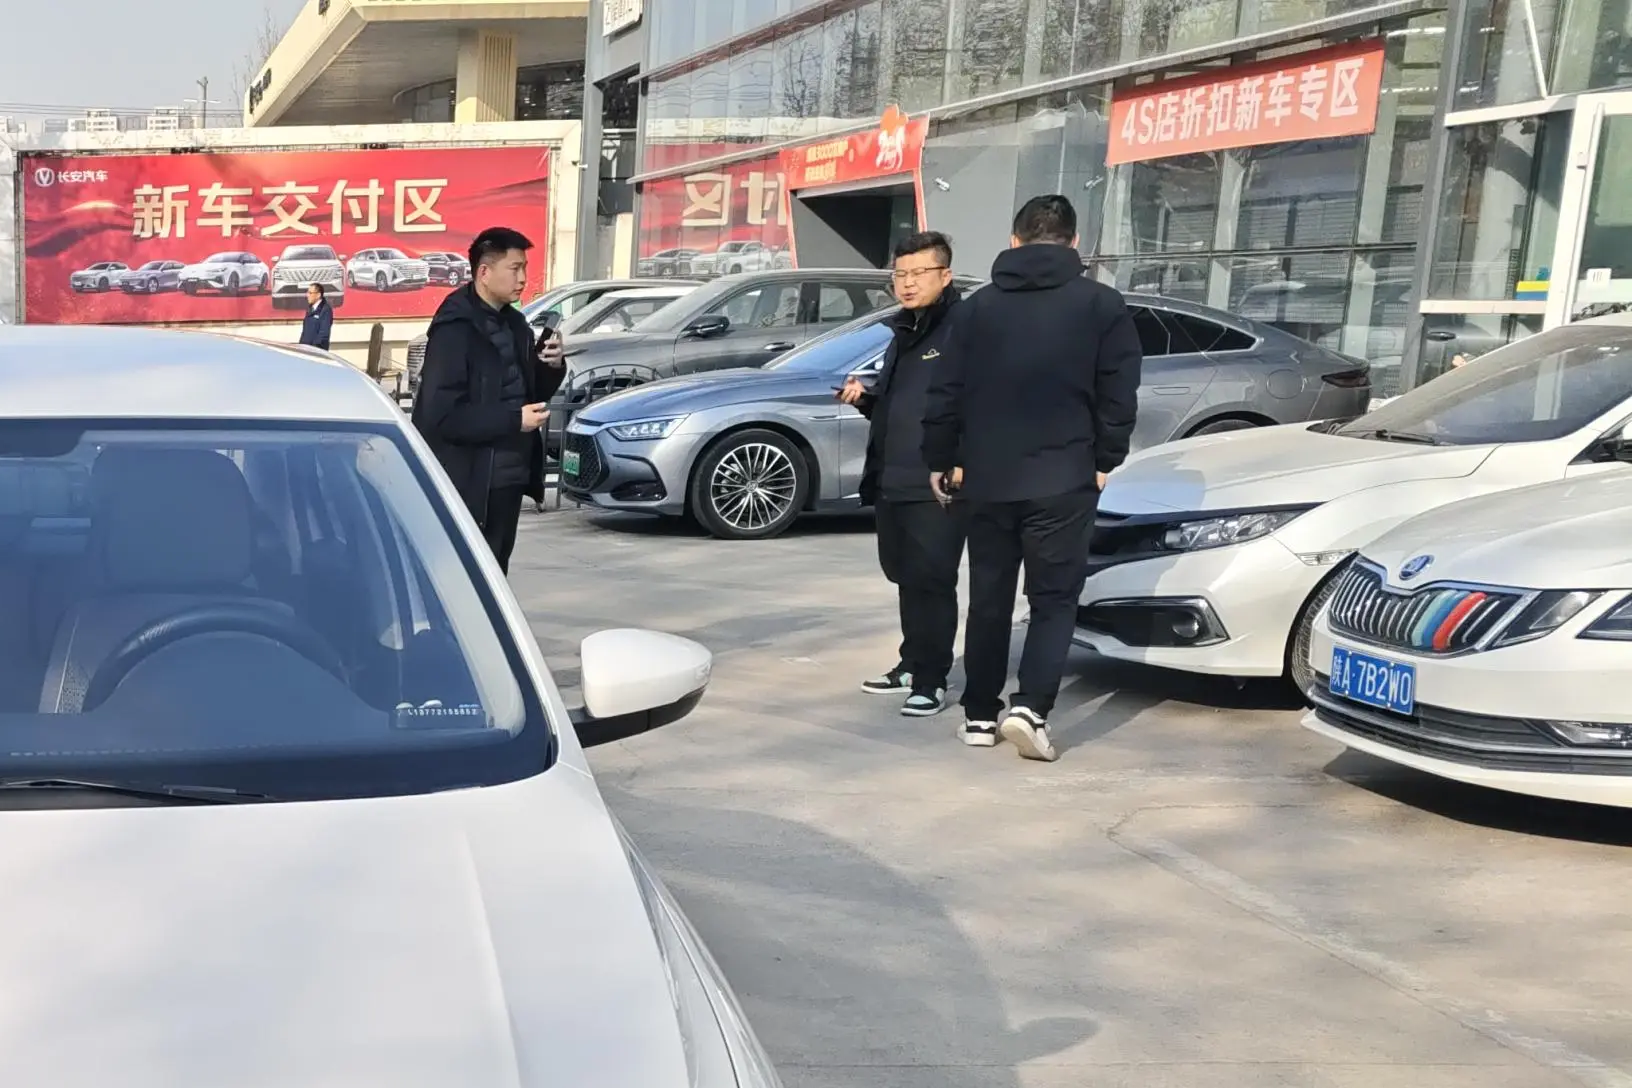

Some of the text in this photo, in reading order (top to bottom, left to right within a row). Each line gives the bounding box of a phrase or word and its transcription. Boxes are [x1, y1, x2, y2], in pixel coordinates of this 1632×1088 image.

[1121, 57, 1364, 146] 4S店折扣新车专区
[57, 169, 109, 184] 长安汽车
[132, 178, 448, 239] 新车交付区
